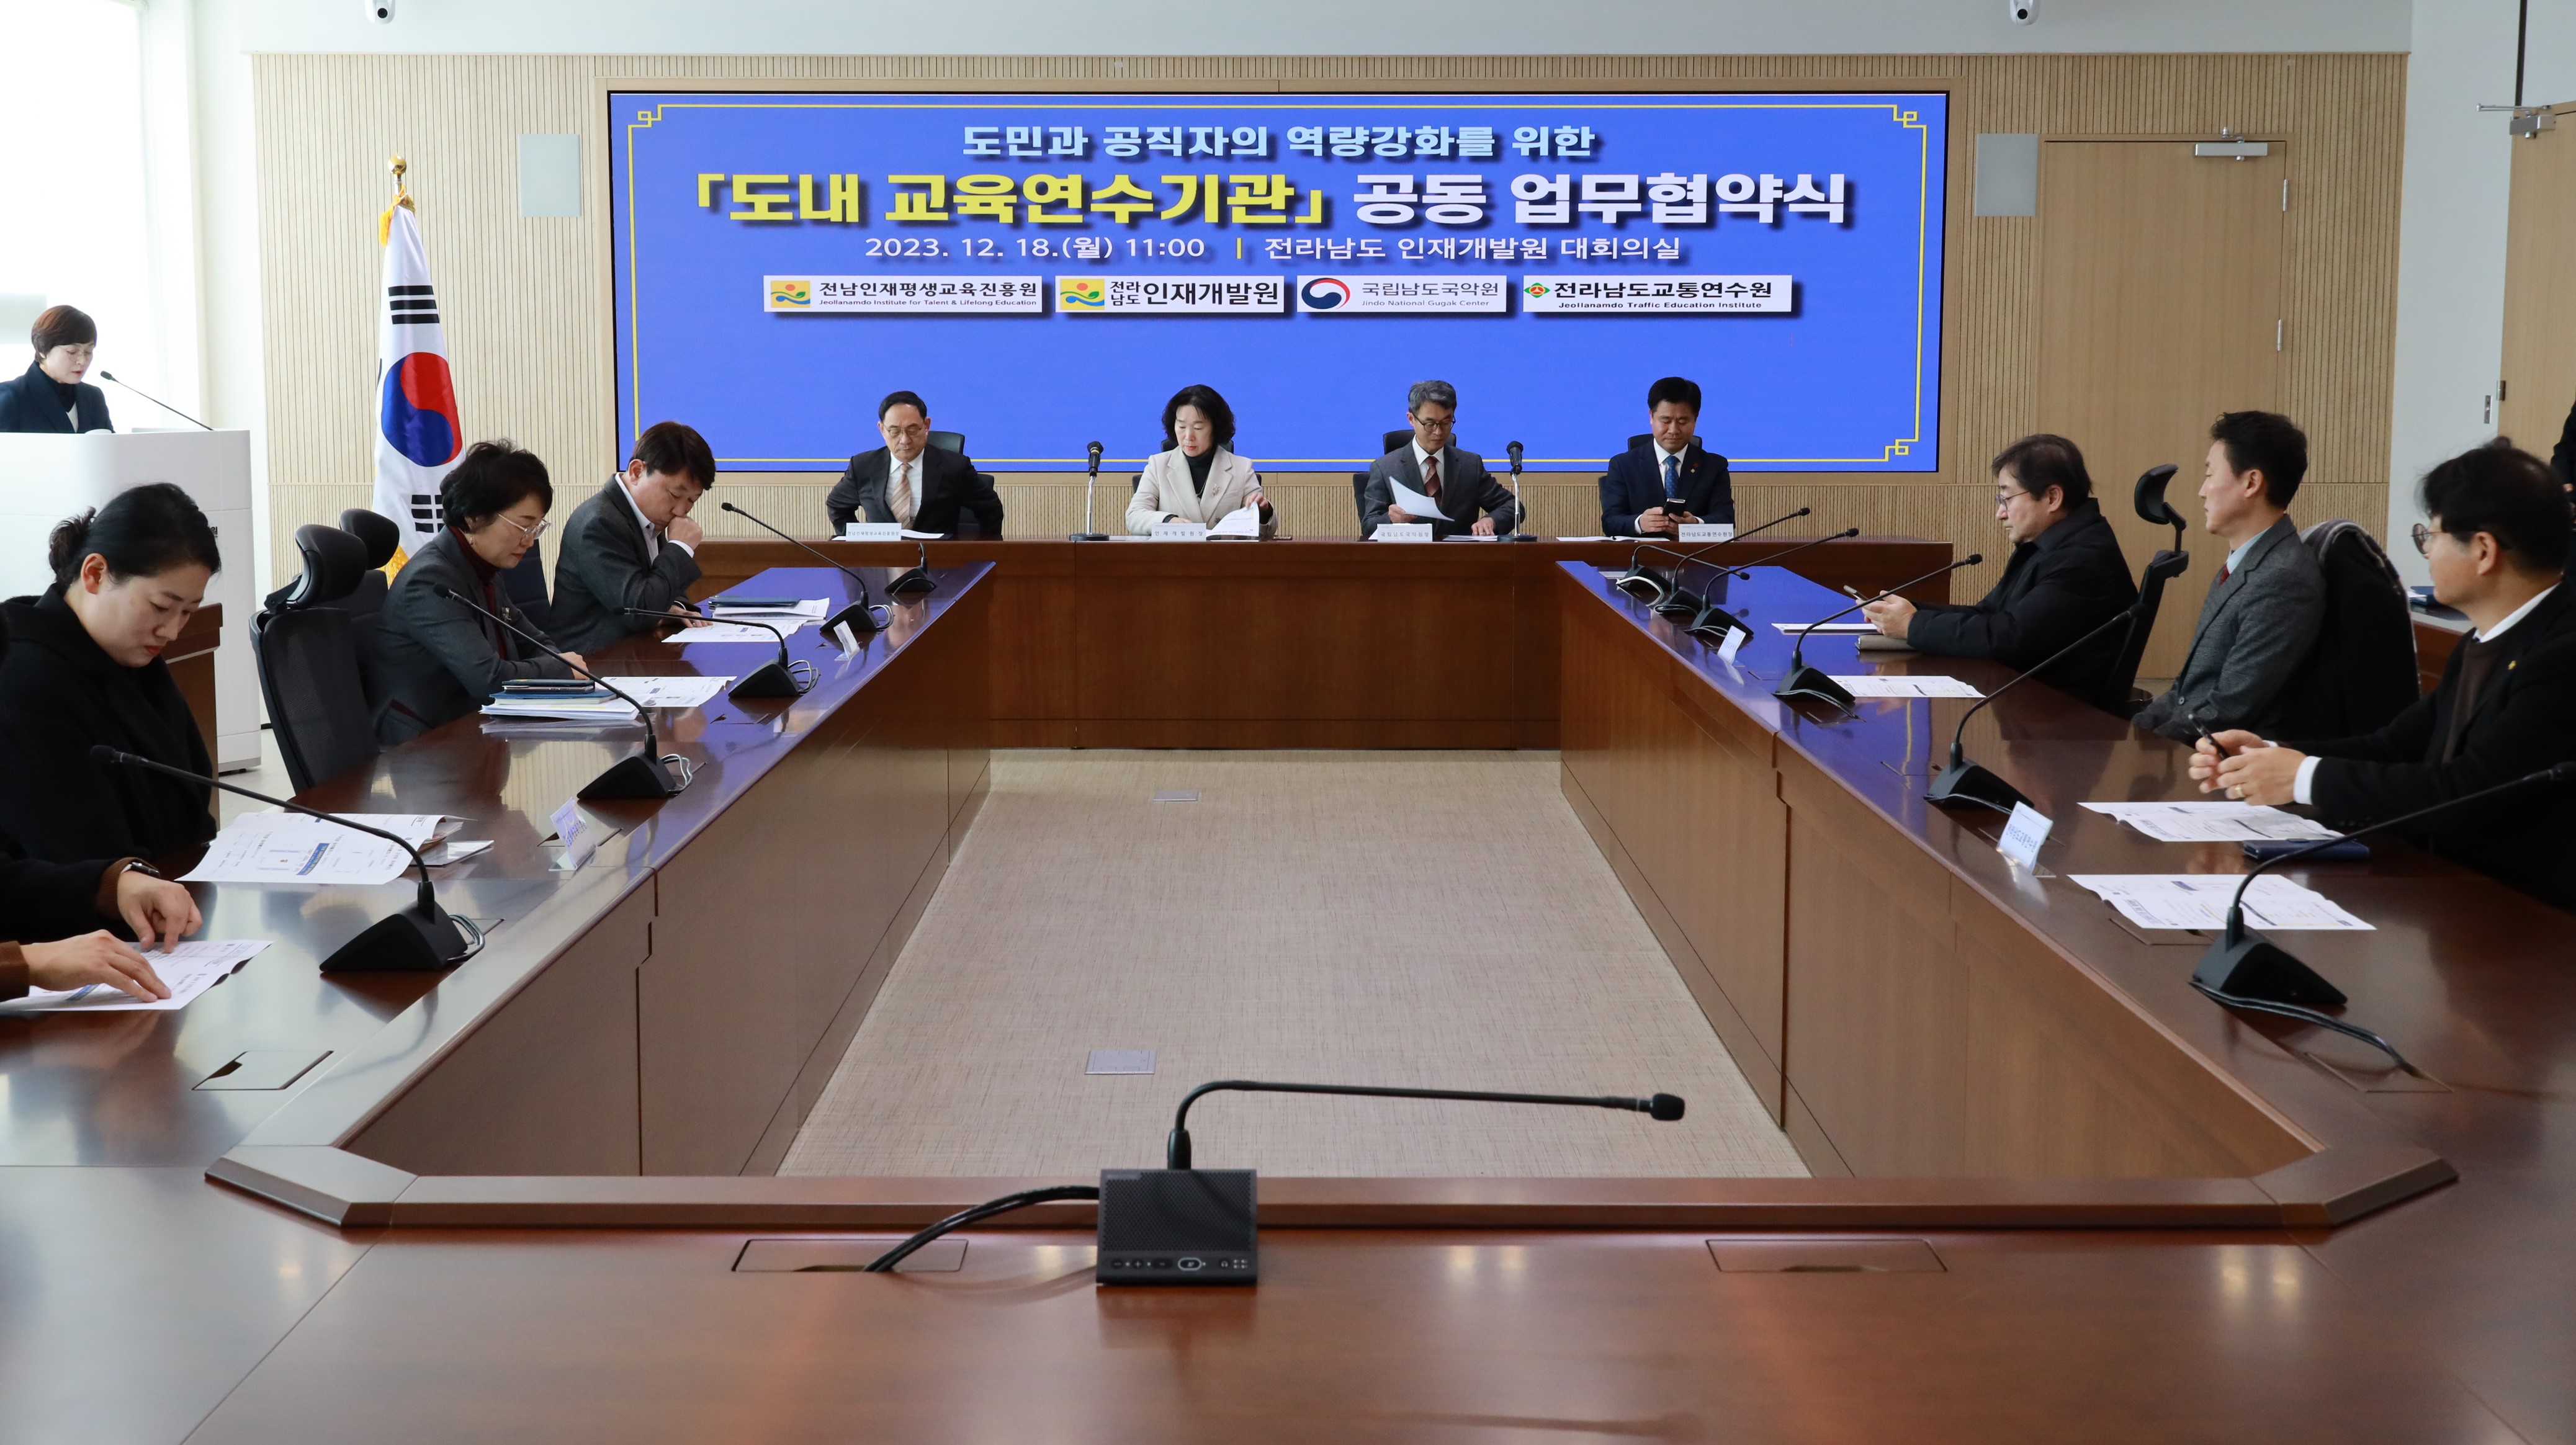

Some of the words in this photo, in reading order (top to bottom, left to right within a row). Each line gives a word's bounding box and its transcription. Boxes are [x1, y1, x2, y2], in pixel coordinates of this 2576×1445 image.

[963, 126, 1088, 156] 도민과
[1103, 126, 1267, 156] 공직자의
[1287, 126, 1495, 156] 역량강화를
[1512, 125, 1595, 156] 위한
[698, 173, 859, 223] 「도내
[885, 174, 1322, 223] 교육연수기관」
[1353, 174, 1486, 224] 공동
[1510, 173, 1844, 223] 업무협약식
[865, 238, 948, 257] 2023.
[961, 238, 1003, 257] 12.
[1016, 236, 1113, 259] 18.(월)
[1126, 238, 1205, 257] 11:00
[1265, 237, 1386, 259] 전라남도
[1398, 237, 1547, 259] 인재개발원
[1561, 237, 1679, 259] 대회의실
[819, 282, 1036, 297] 전남인재평생교육진흥원
[1110, 281, 1141, 293] 전라
[1144, 282, 1278, 305] 인재개발원
[1362, 282, 1498, 297] 국립남도국악원
[1554, 282, 1771, 298] 전라남도교통연수원
[1111, 293, 1141, 306] 남도
